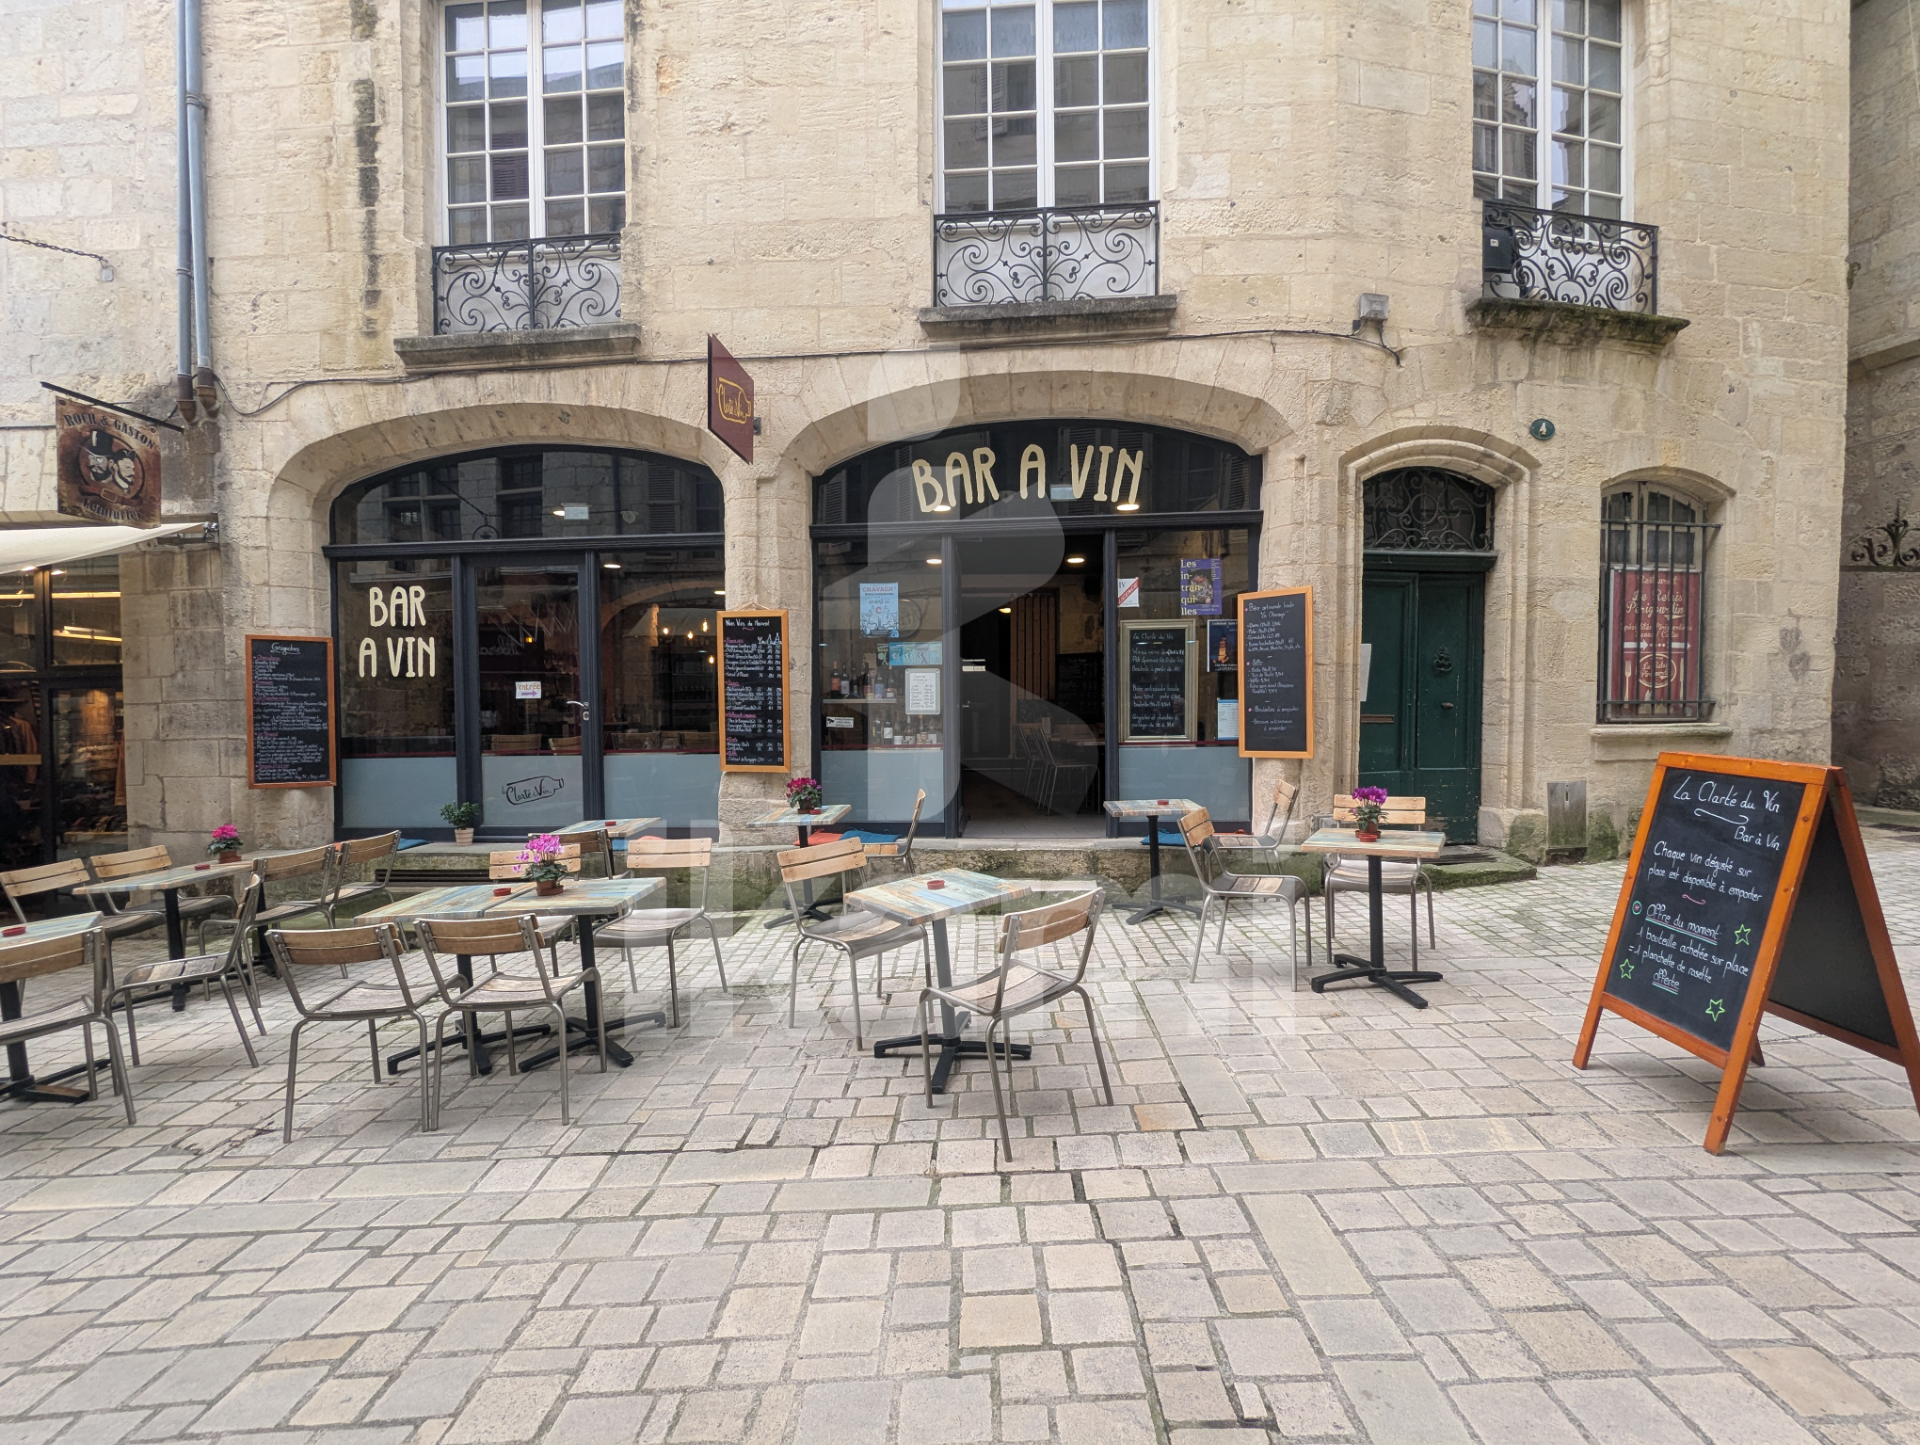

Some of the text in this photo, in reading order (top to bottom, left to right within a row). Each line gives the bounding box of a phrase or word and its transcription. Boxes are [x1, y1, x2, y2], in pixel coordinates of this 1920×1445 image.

[63, 411, 155, 450] ROCH & GASTON
[912, 443, 1144, 513] BAR A VIN
[1180, 559, 1197, 569] Les
[1180, 571, 1193, 580] in-
[369, 585, 427, 627] BAR
[1180, 606, 1198, 616] lles
[358, 637, 378, 678] A
[387, 636, 436, 678] VIN
[1673, 776, 1780, 814] La Clarté du Vin
[1734, 825, 1780, 851] Bar à Vin
[1653, 840, 1752, 878] Chaque vin dégusté sur
[1647, 864, 1763, 904] place est disponible à emporter
[1645, 903, 1721, 941] Offre du moment
[1637, 925, 1750, 979] 1 bouteille achetée sur place
[1641, 944, 1676, 968] planchette
[1677, 959, 1686, 973] de
[1687, 963, 1713, 985] rosette
[1652, 970, 1681, 990] offerte
